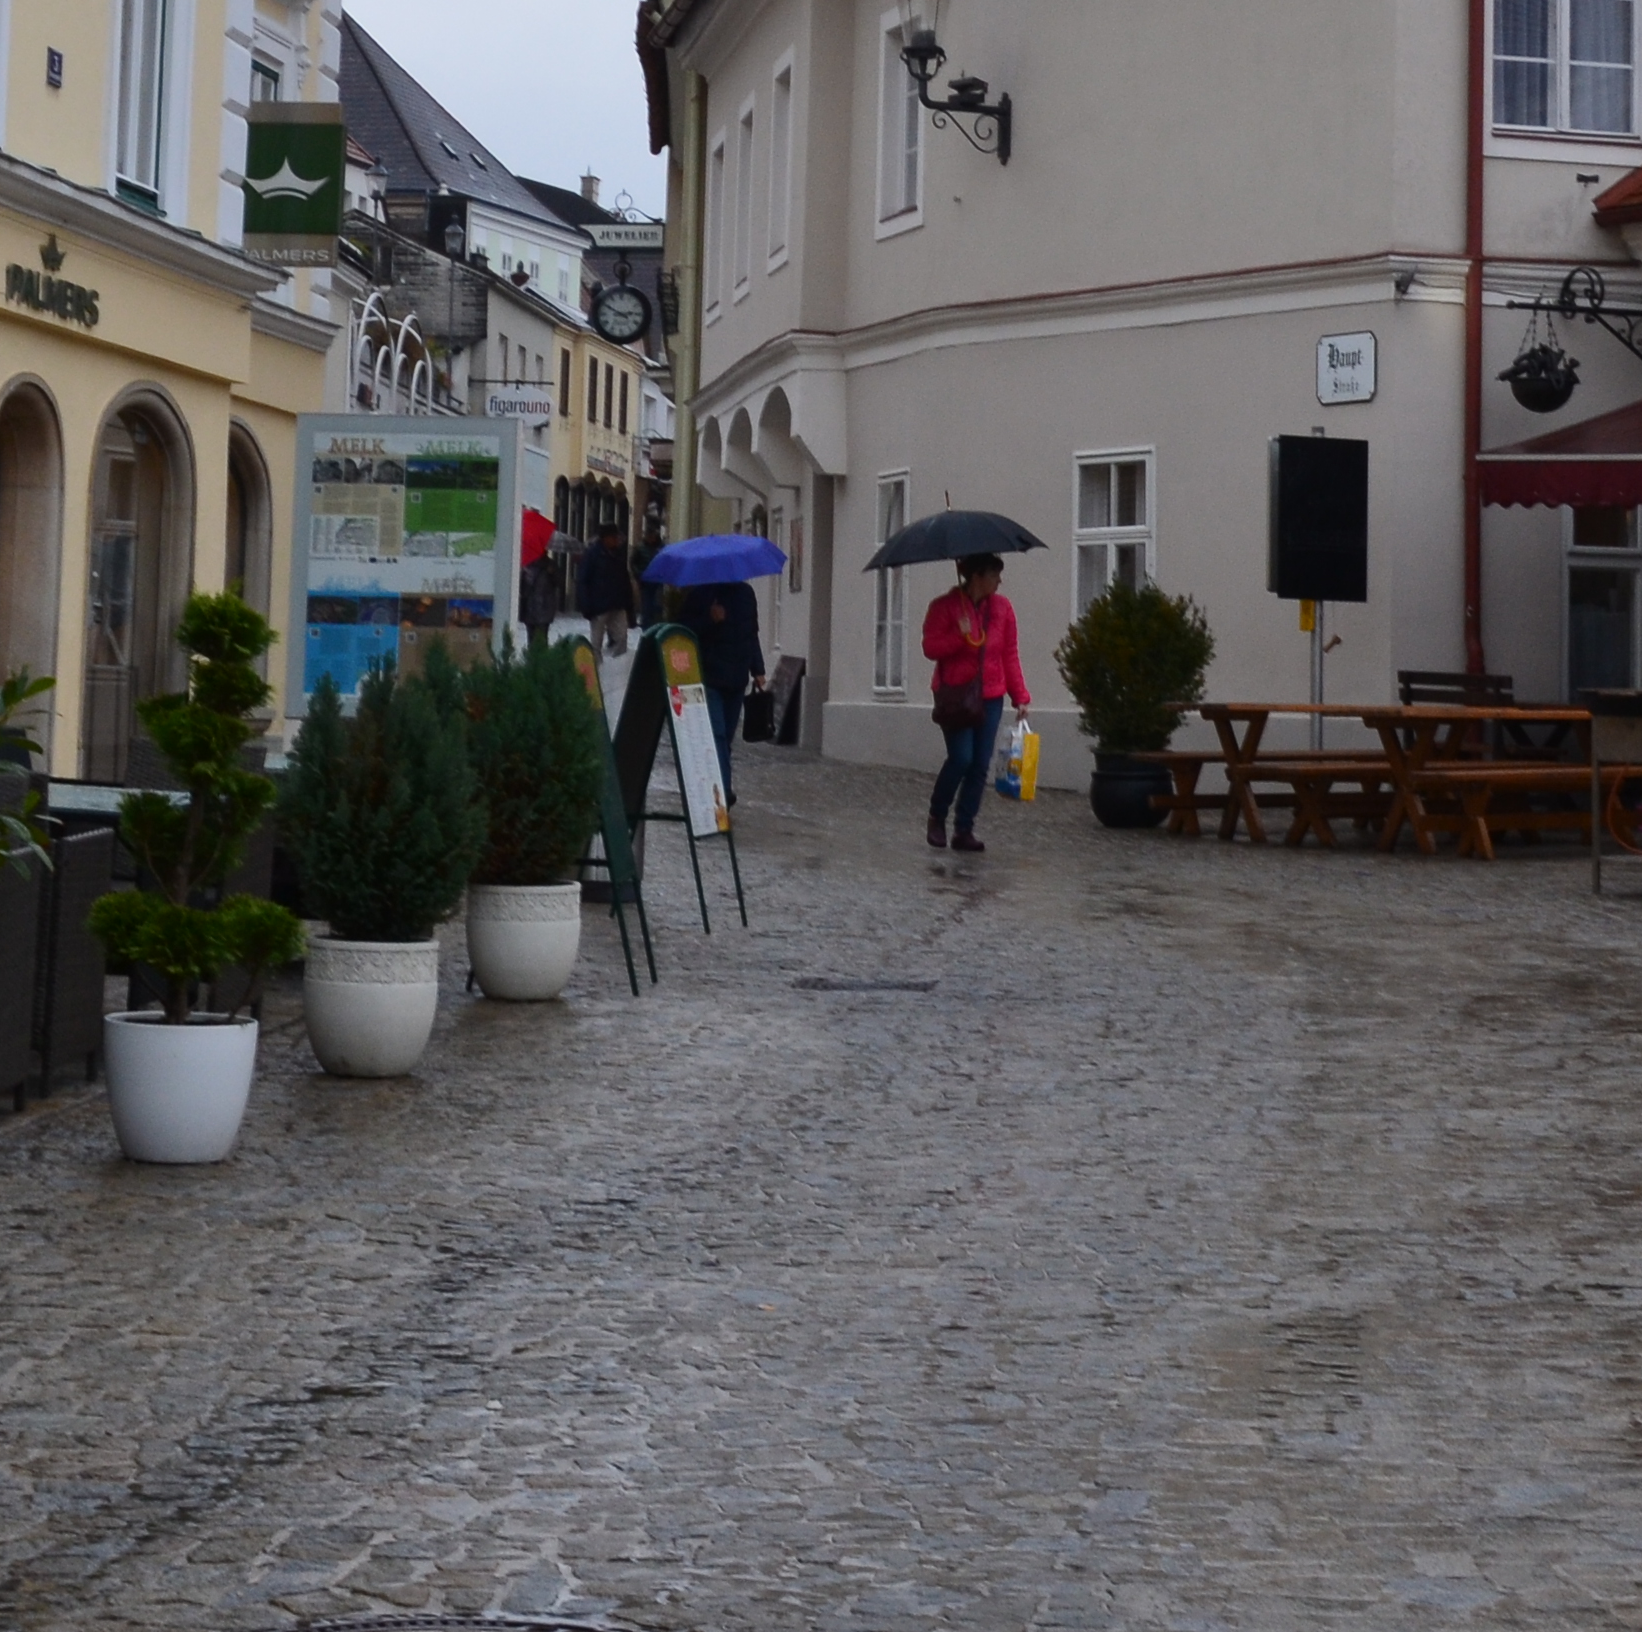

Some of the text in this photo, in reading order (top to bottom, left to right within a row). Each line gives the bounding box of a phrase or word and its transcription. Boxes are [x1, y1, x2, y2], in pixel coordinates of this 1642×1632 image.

[598, 230, 659, 241] JUWELIER
[244, 248, 330, 262] ALMERS
[5, 262, 99, 328] PALMERS
[489, 395, 551, 417] figarouno
[328, 436, 386, 456] MELK
